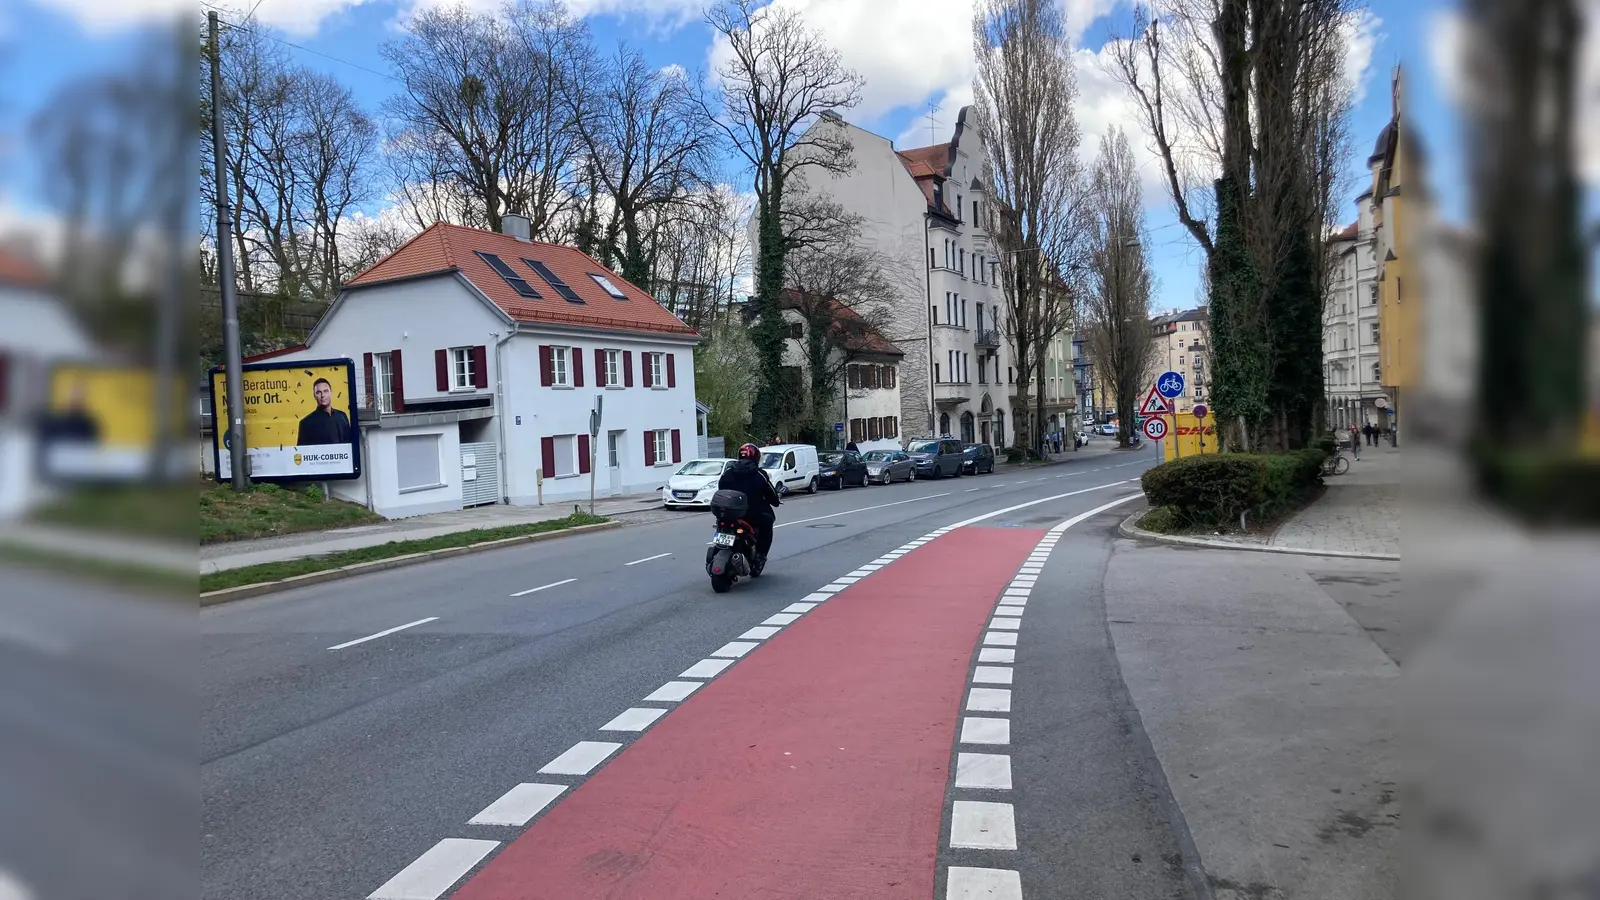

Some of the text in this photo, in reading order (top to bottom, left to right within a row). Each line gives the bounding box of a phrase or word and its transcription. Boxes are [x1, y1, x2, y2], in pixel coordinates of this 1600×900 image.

[243, 379, 291, 392] Beratung.
[244, 392, 282, 405] vor Ort.
[1148, 422, 1163, 434] 30
[303, 453, 349, 461] HUK-COBURG
